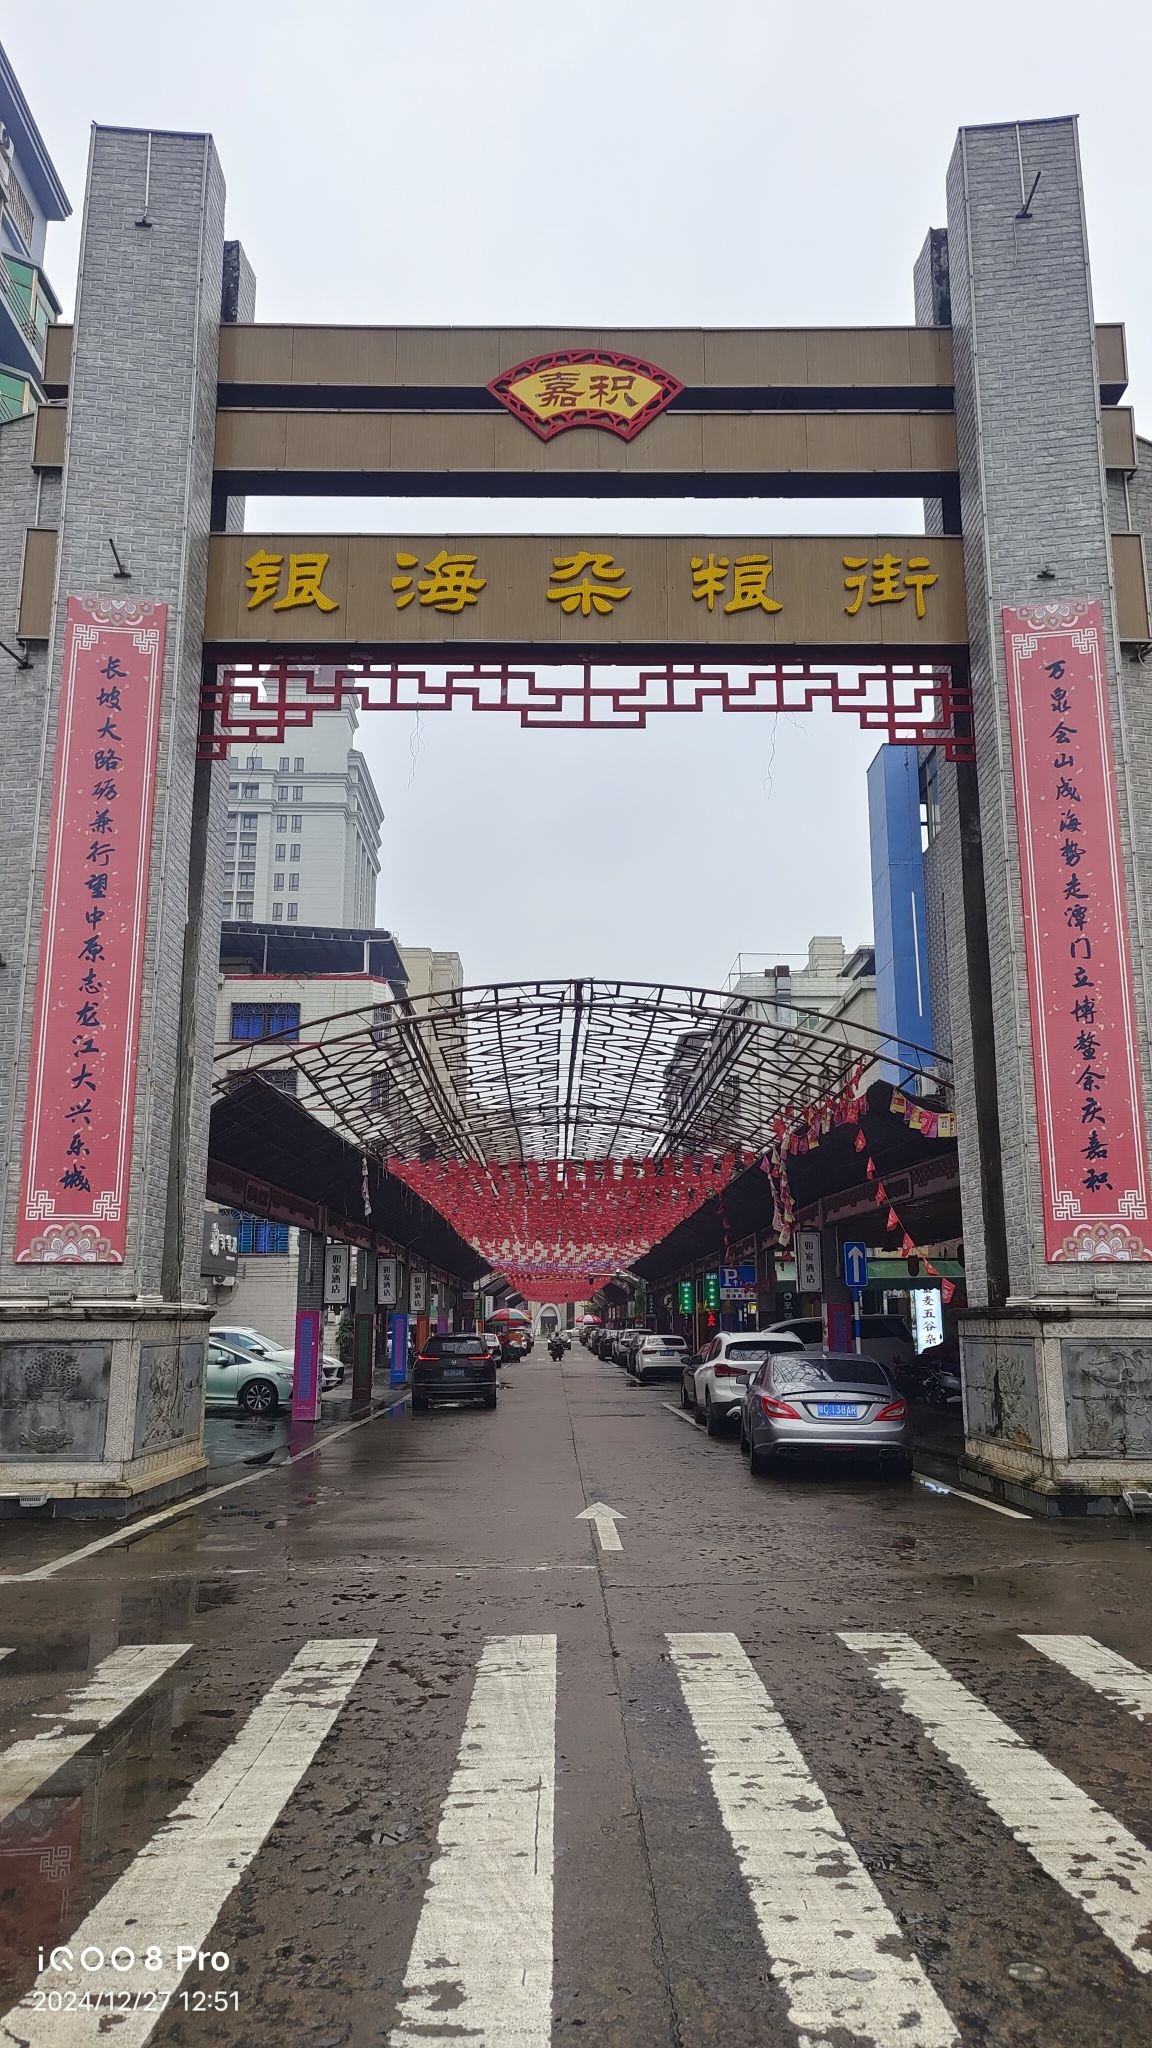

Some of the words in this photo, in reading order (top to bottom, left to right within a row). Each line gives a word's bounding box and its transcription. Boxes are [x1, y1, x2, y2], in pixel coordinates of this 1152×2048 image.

[536, 371, 639, 408] 嘉积
[245, 548, 939, 619] 银海杂粮街
[331, 1254, 342, 1294] 如家酒店
[383, 1266, 391, 1297] 如家酒店
[723, 1268, 738, 1287] P
[804, 1241, 815, 1284] 如家酒店
[922, 1289, 937, 1345] 麦五谷杂
